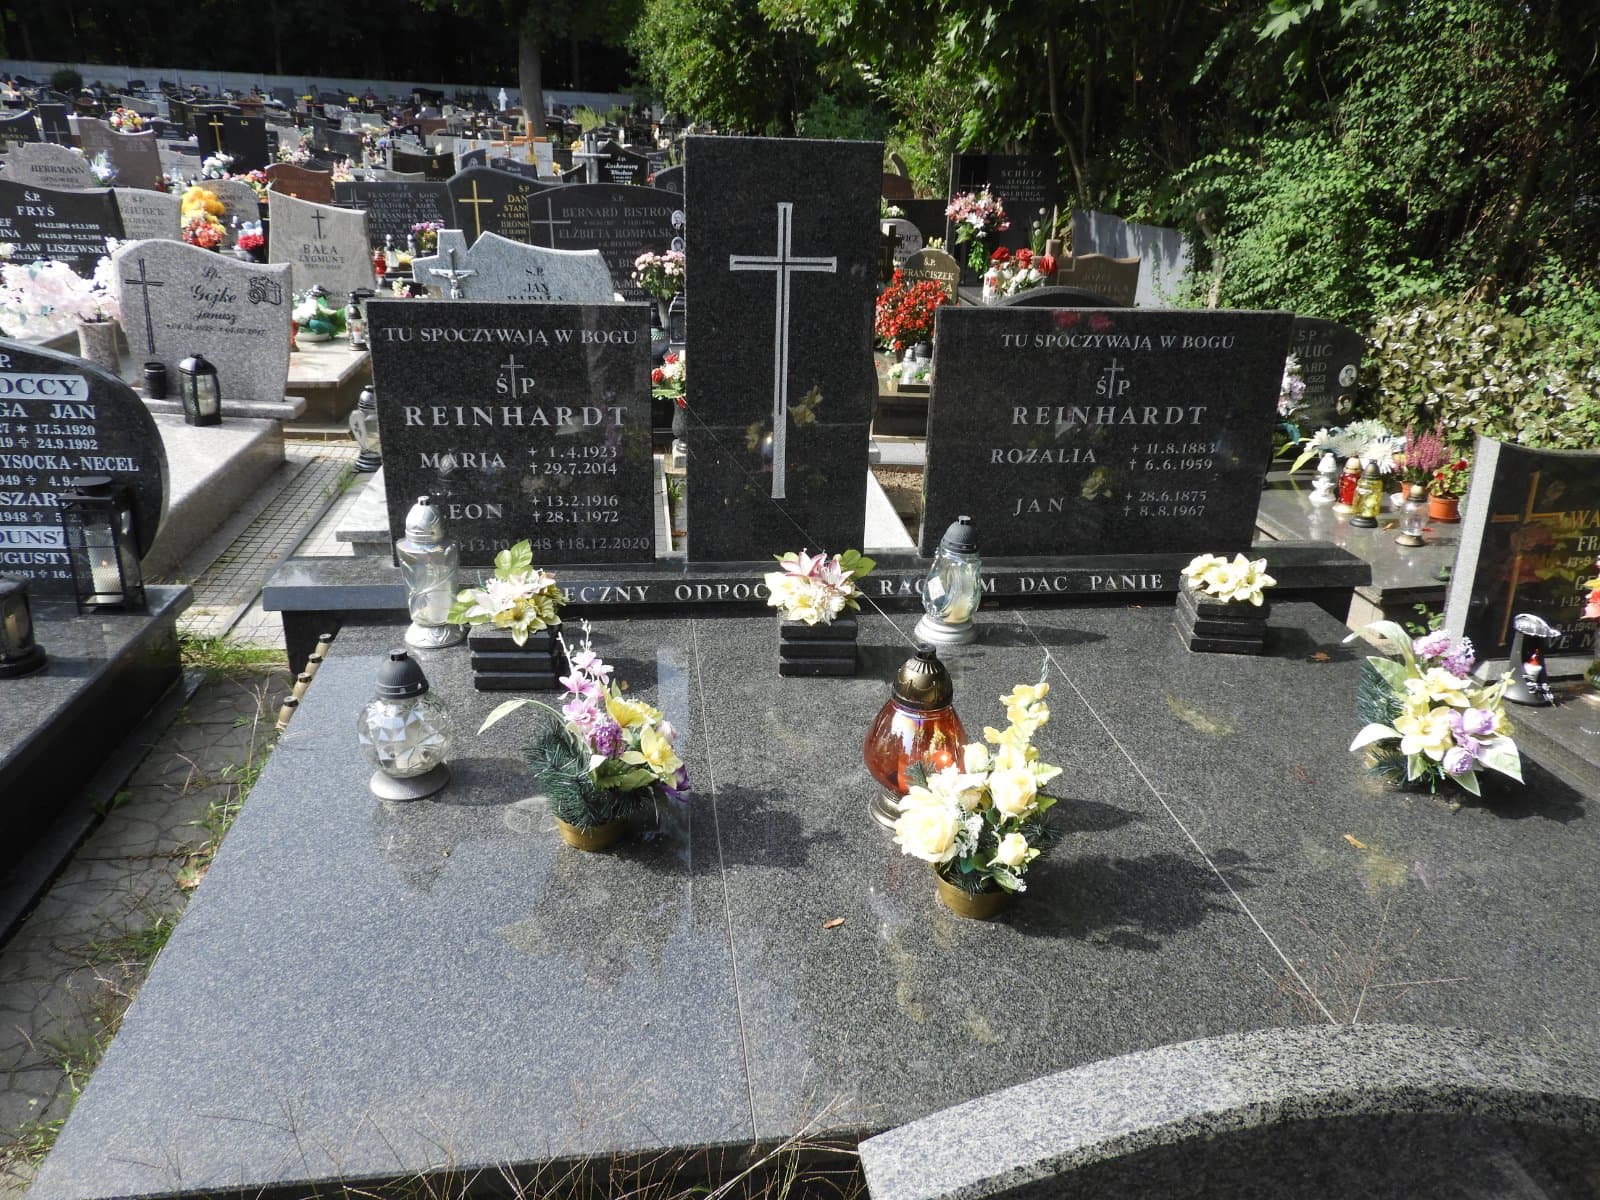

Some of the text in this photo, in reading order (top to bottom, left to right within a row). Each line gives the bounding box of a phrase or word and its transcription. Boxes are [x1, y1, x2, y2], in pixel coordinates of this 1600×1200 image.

[16, 203, 56, 216] FRYŚ
[562, 207, 618, 218] BERNARD
[47, 244, 107, 254] LISZEWSKI
[383, 327, 638, 346] TU SPOCZYWAJĄ W BOGU
[1001, 334, 1236, 351] TU SPOCZYWAJĄ W BOGU
[50, 403, 96, 419] JAN
[403, 405, 628, 426] REINHARDT
[1011, 405, 1208, 425] REINHARDT
[34, 424, 96, 436] 17.5.1920
[37, 439, 98, 450] 24.9.1992
[420, 451, 507, 468] MARIA
[443, 502, 503, 520] EON
[1013, 498, 1065, 517] JAN
[565, 585, 649, 603] ECZNY
[674, 583, 770, 601] ODPOC
[1089, 573, 1164, 591] PANIE
